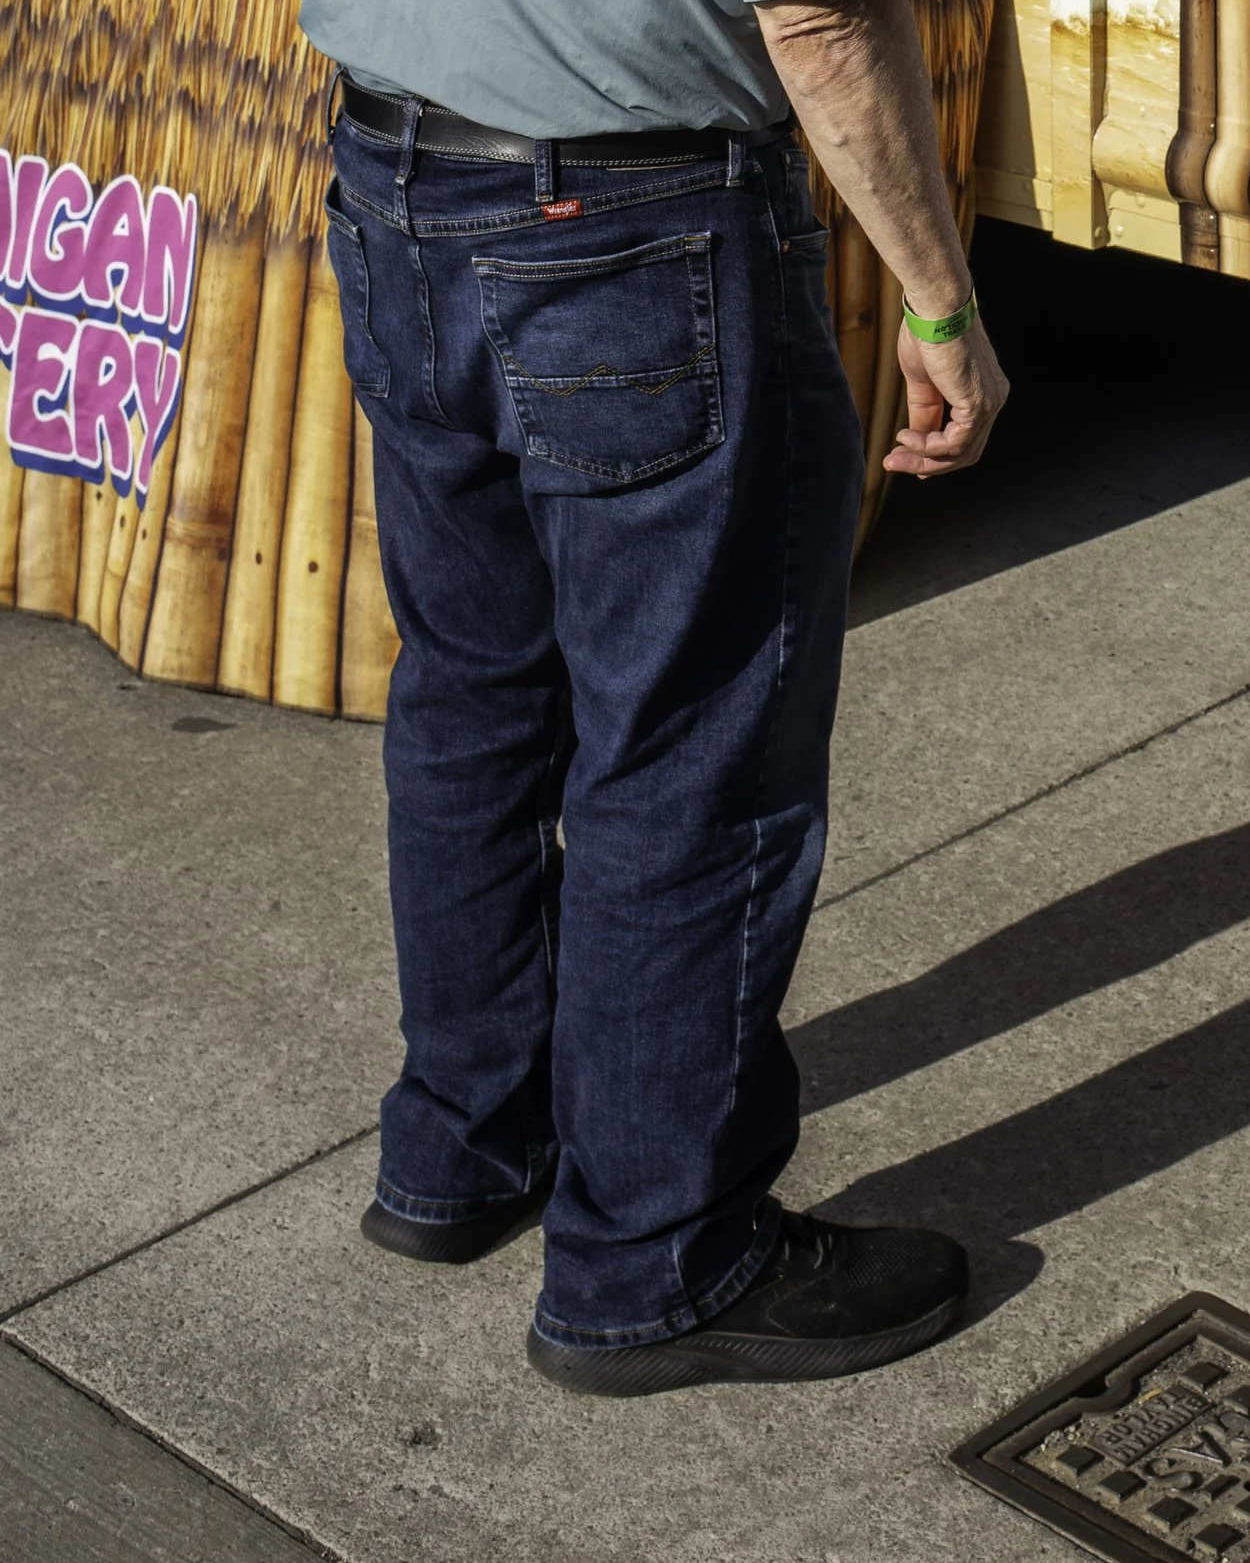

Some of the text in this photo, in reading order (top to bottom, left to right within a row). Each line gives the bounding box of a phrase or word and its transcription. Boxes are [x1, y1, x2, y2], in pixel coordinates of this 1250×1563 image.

[547, 202, 577, 215] Wrangler
[1102, 1388, 1187, 1446] TAYLOR
[1115, 1395, 1206, 1462] BINGHAM
